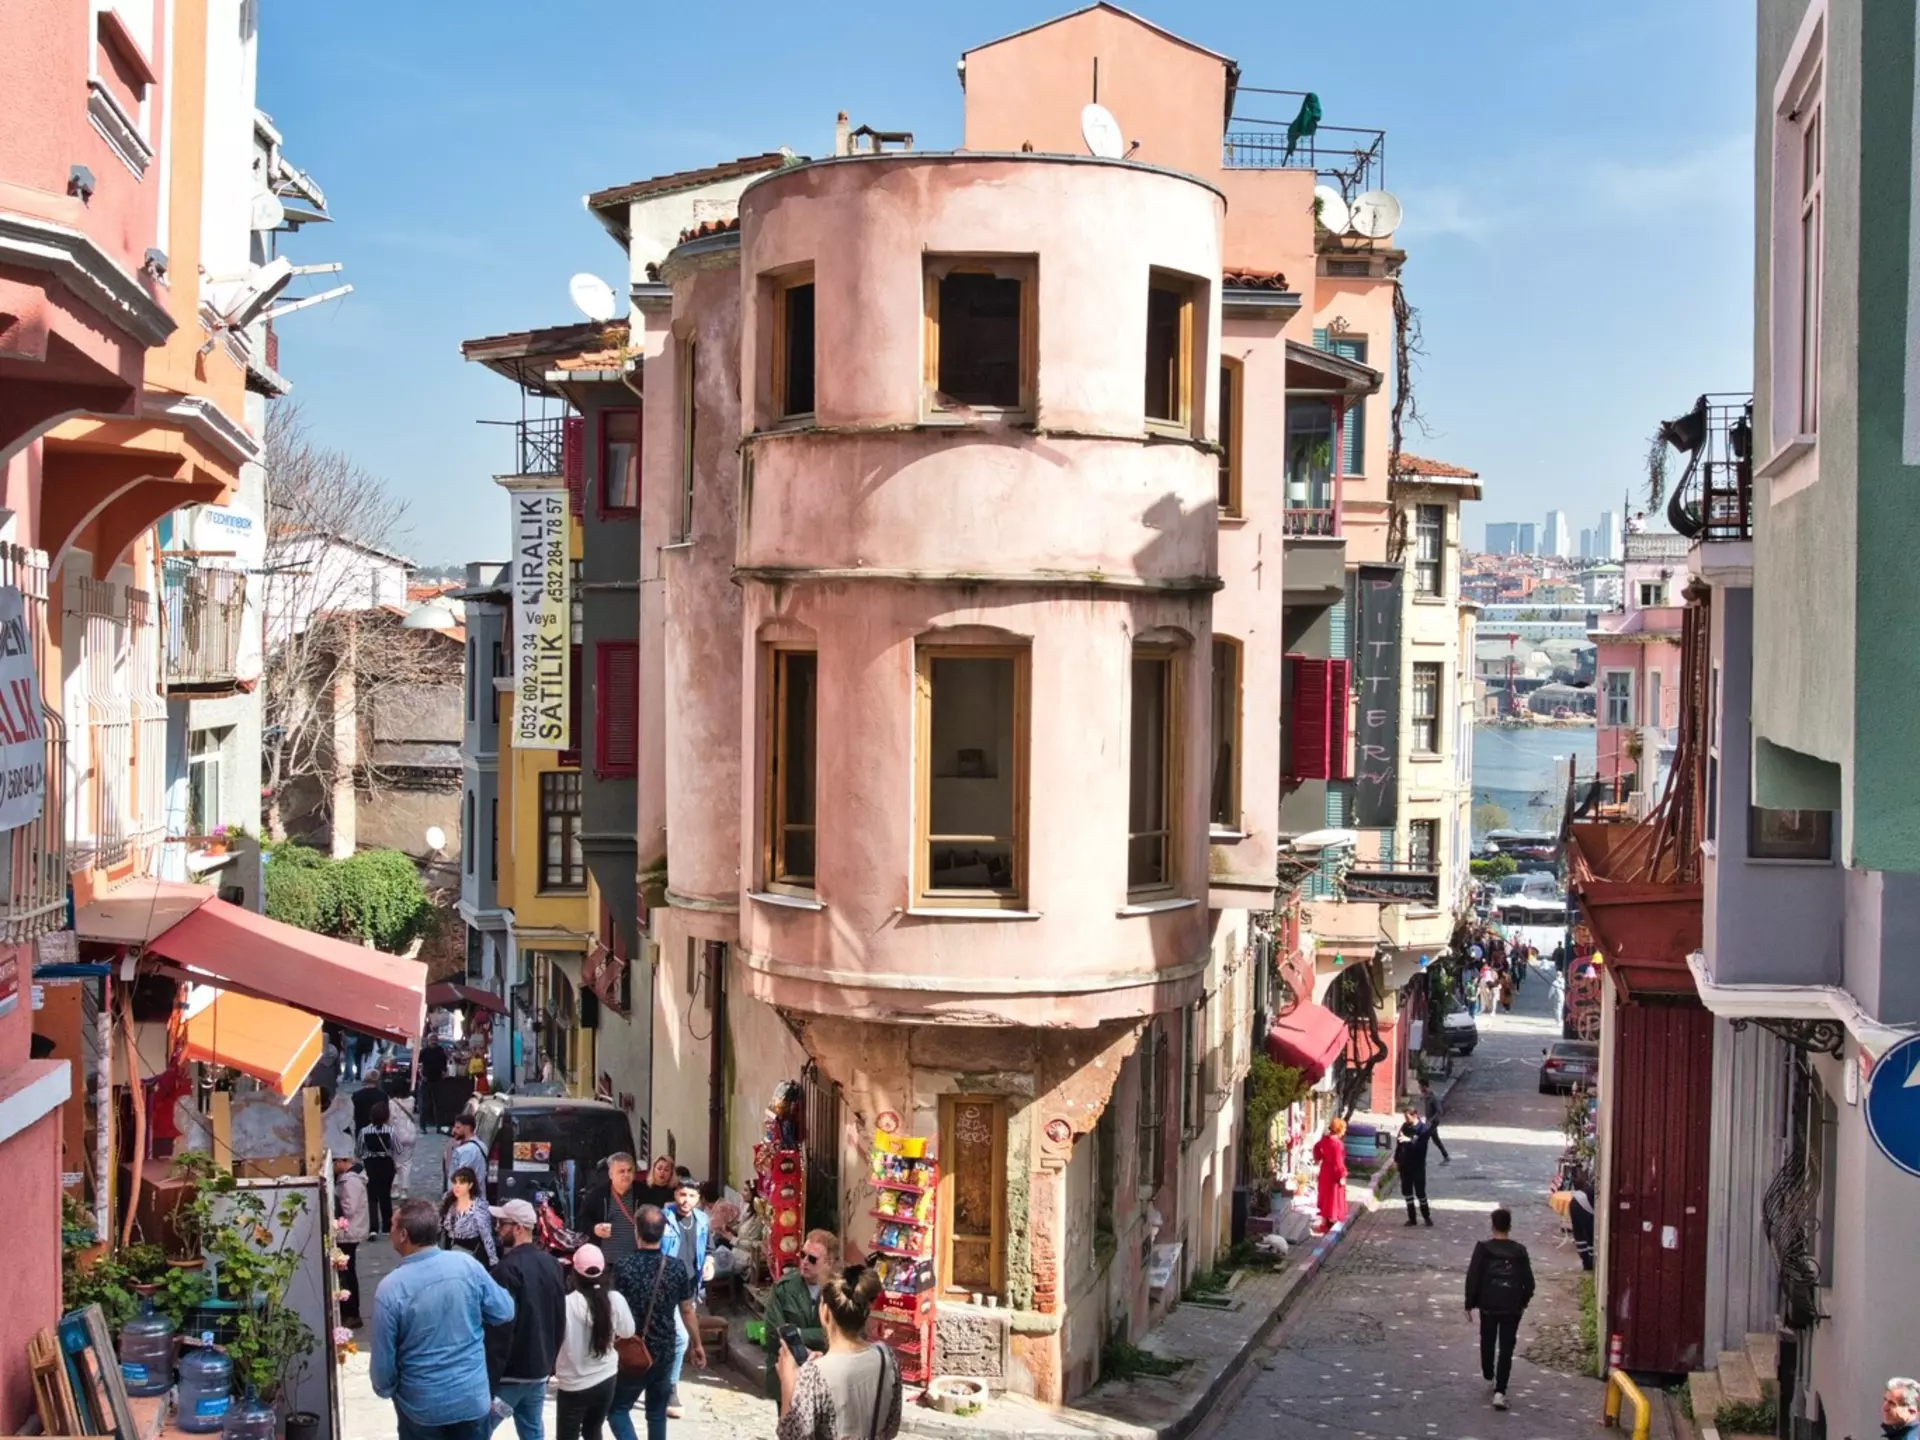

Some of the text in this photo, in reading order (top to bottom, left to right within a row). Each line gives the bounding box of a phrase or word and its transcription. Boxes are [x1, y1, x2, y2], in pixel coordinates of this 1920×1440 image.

[547, 498, 564, 603] 532 284 78 57
[526, 610, 557, 627] Veya
[521, 633, 538, 739] 0532 602 32 34
[539, 634, 563, 739] SATILIK
